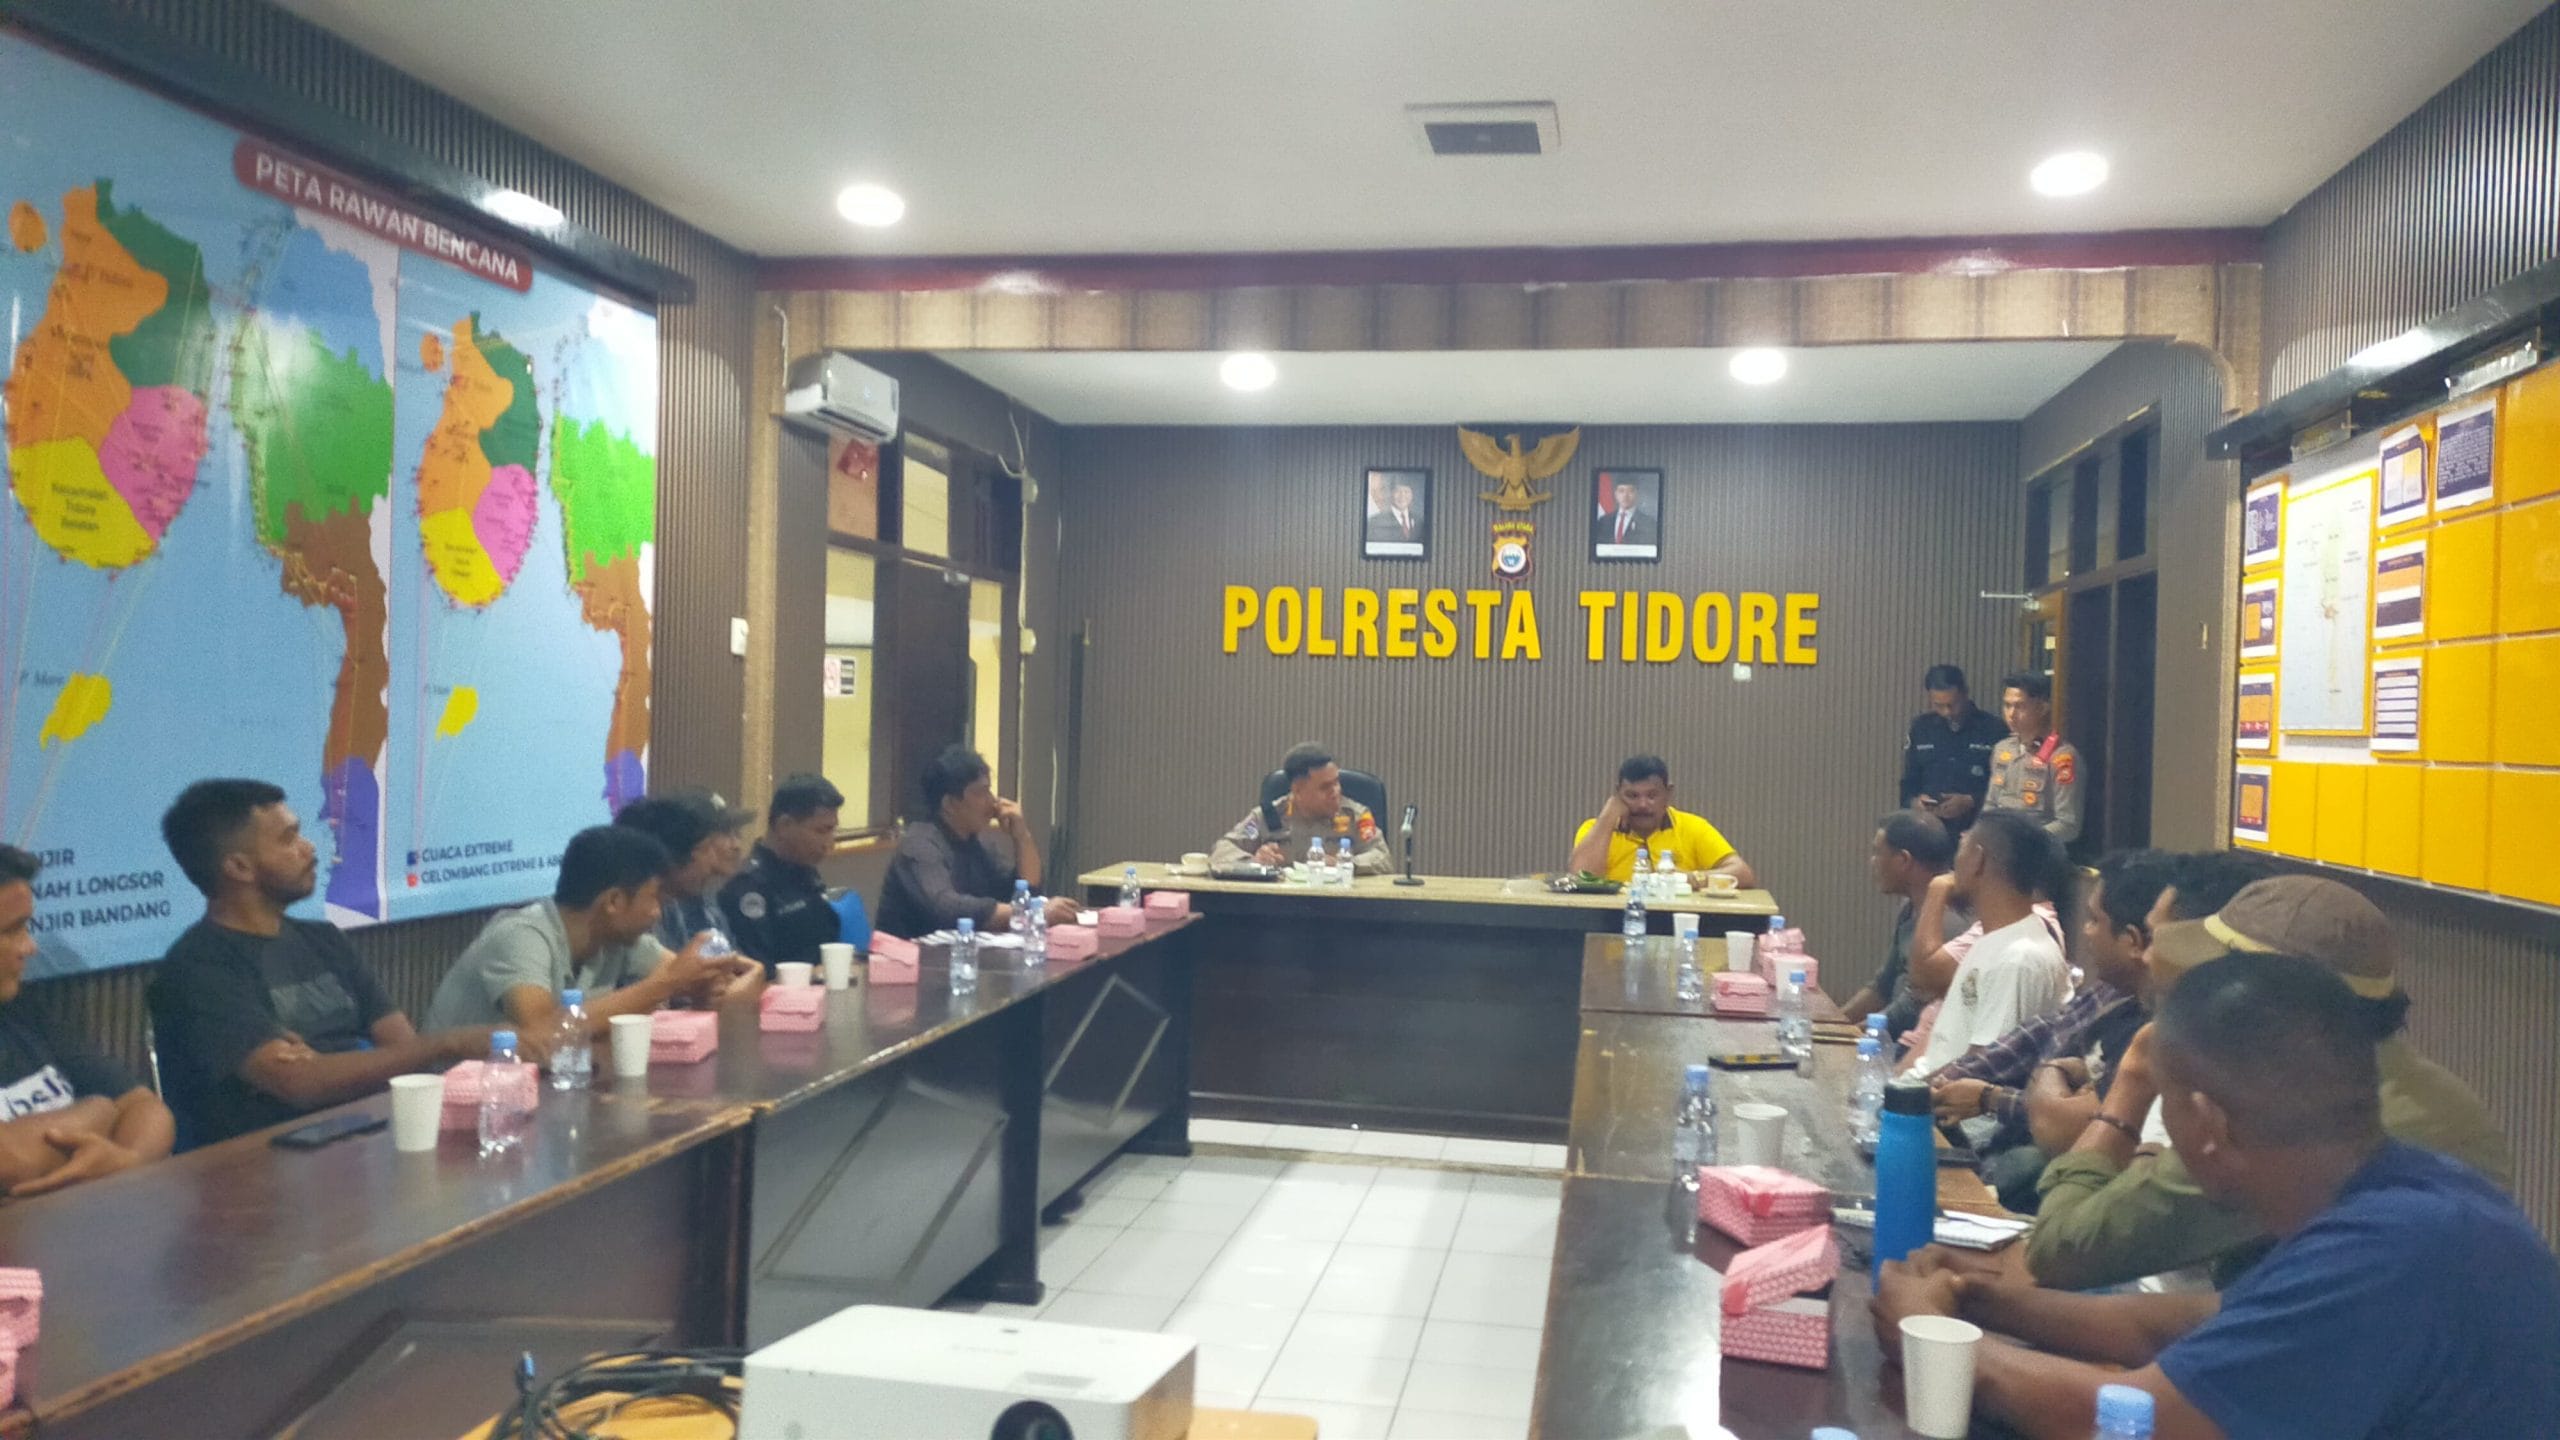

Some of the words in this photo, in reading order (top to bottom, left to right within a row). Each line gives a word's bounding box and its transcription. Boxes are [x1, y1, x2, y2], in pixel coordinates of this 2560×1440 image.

[256, 151, 323, 206] PETA
[329, 182, 418, 243] RAWAN
[423, 220, 520, 284] BENCANA
[1222, 584, 1542, 660] POLRESTA
[1579, 590, 1820, 666] TIDORE
[35, 848, 75, 868] NJIR
[421, 845, 463, 863] CUACA
[465, 839, 514, 858] EXTREME
[32, 880, 71, 900] NAH
[76, 870, 165, 897] LONGSOR
[29, 912, 75, 934] NJIR
[80, 899, 172, 928] BANDANG
